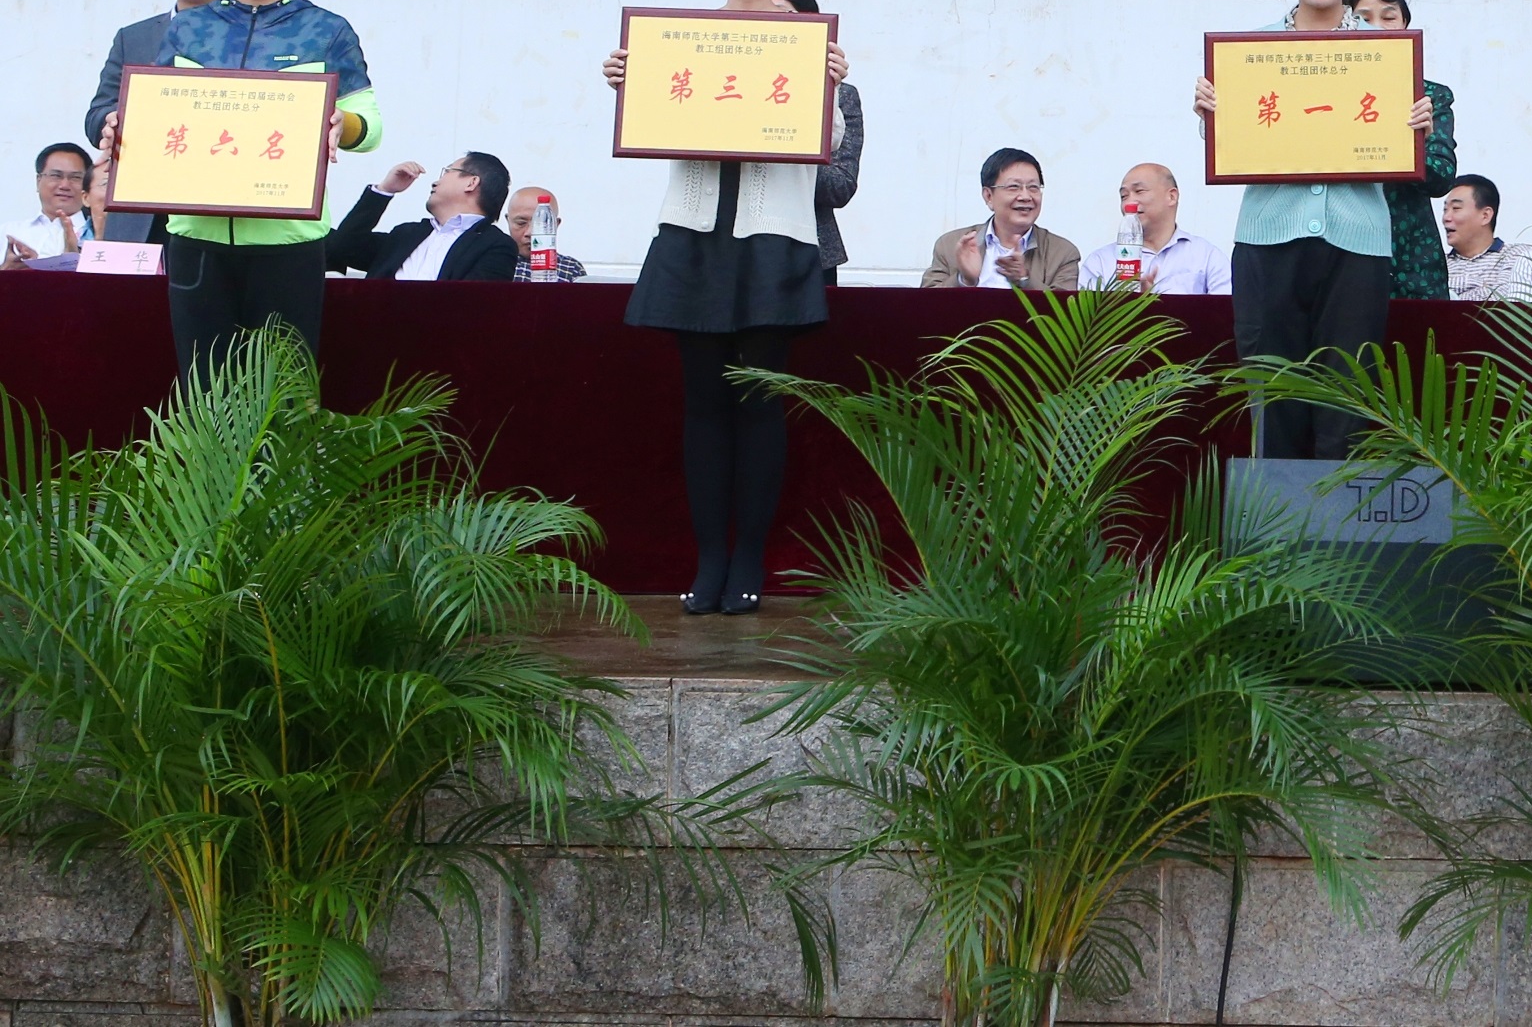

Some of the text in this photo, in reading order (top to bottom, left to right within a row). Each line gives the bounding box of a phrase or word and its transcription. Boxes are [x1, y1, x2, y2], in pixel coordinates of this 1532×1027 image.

[661, 30, 798, 45] 海南师范大学第三十四届运动会
[695, 44, 763, 56] 教工组团体总分
[1245, 52, 1383, 65] 海南师范大学第三十四届运动会
[1279, 66, 1348, 76] 教工组团体总分
[669, 68, 791, 105] 第三名
[160, 87, 296, 102] 海南师范大学第三十四届运动会
[193, 100, 260, 112] 教工组团体总分
[1257, 91, 1380, 129] 第一名
[163, 124, 285, 160] 第六名
[90, 250, 149, 268] 王华
